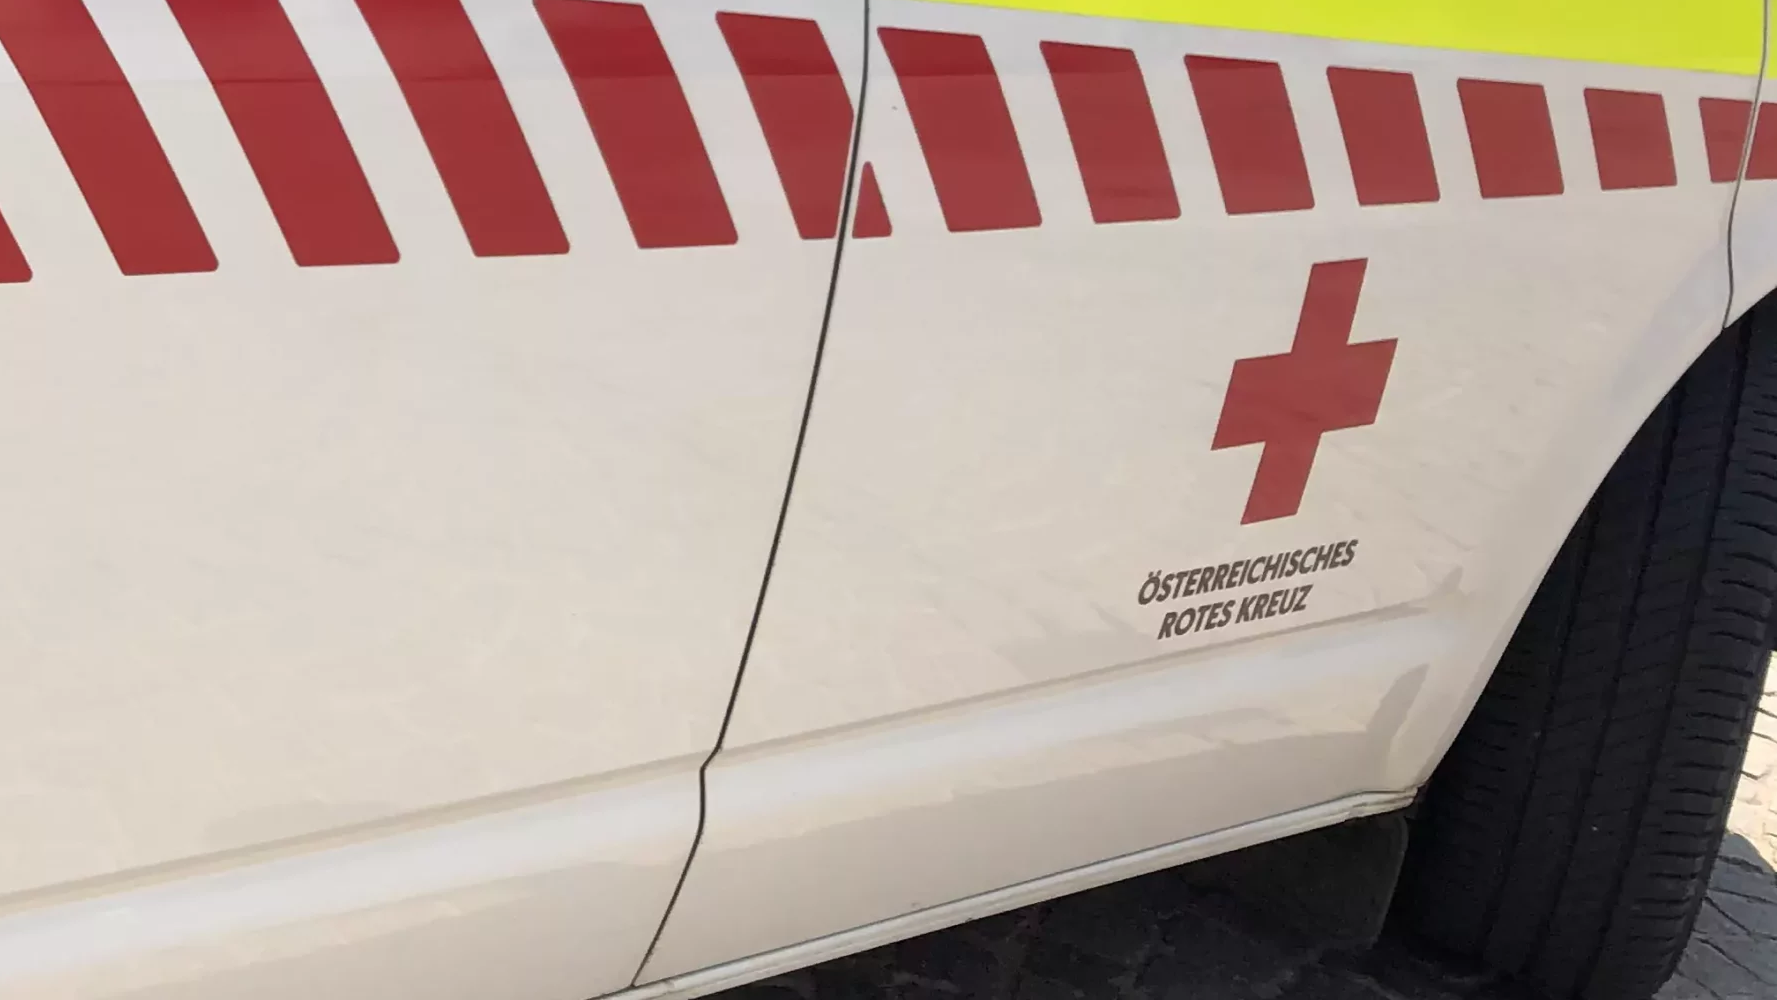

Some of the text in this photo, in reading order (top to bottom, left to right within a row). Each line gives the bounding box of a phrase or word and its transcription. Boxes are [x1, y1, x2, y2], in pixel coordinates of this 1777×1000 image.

[1137, 539, 1359, 606] ÖSTERREICHISCHES
[1157, 584, 1314, 640] ROTES KREUZ
